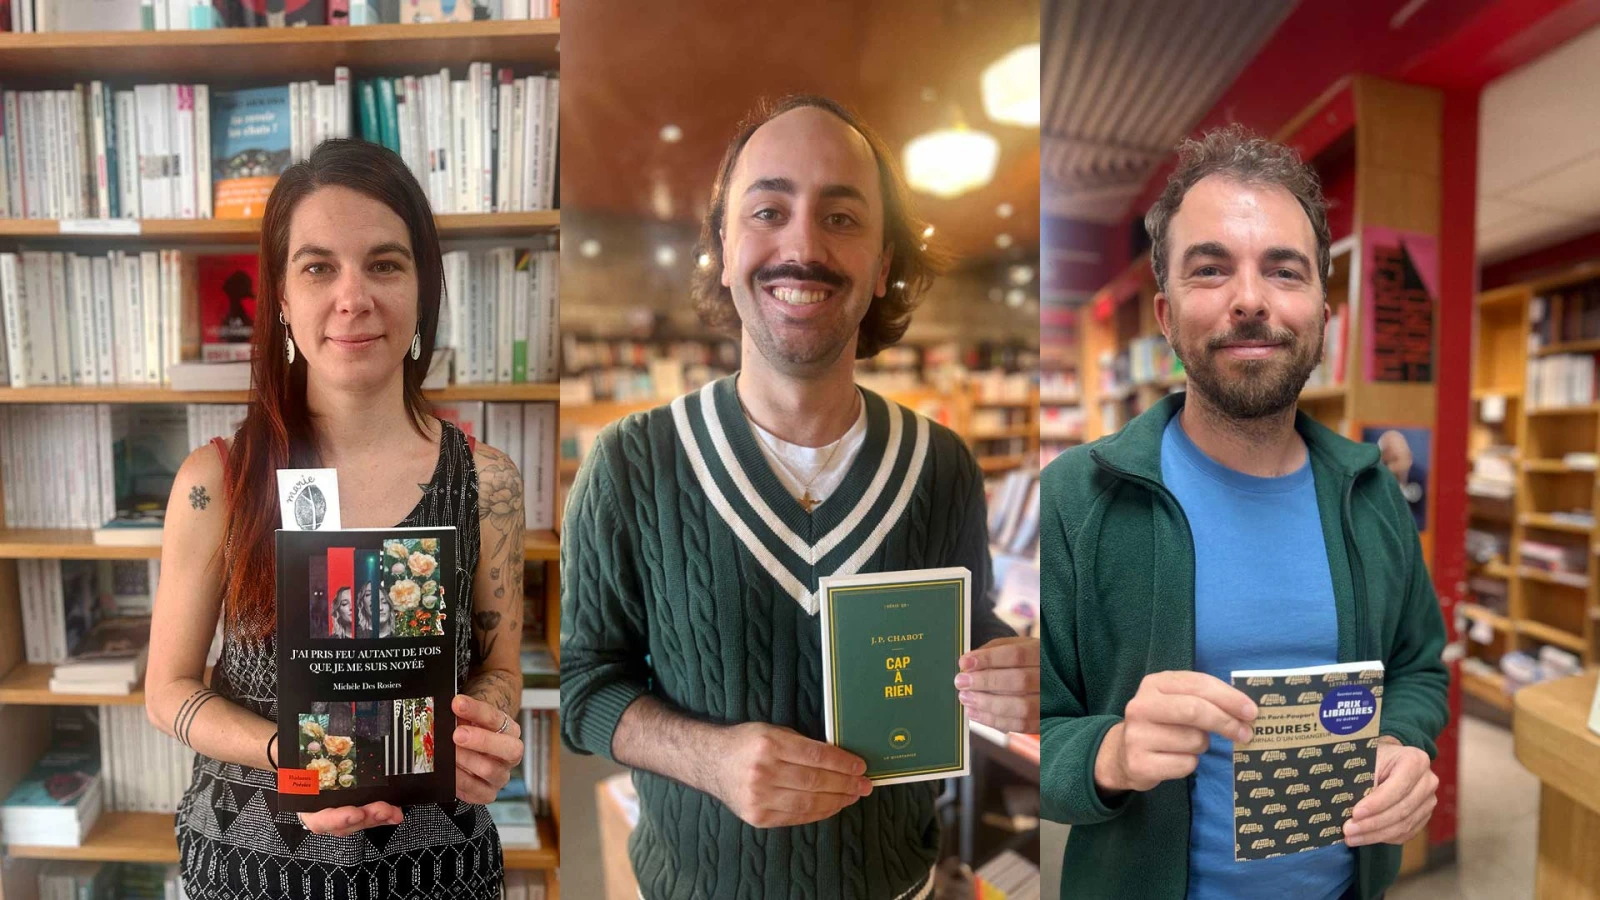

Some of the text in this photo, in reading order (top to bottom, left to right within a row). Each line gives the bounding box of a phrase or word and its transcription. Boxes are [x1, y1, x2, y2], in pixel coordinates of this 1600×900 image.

[286, 474, 316, 504] marie
[887, 633, 924, 643] CHABOT
[290, 646, 442, 660] J'AI PRIS FEU AUTANT DE FOIS
[309, 658, 425, 674] QUE JE ME SUIS NOYÉE
[886, 656, 911, 670] CAP
[894, 668, 903, 683] À
[333, 681, 402, 691] Michèle Des Rosiers
[884, 684, 913, 698] RIEN
[1337, 700, 1361, 709] PRIX
[1323, 706, 1373, 718] LIBRAIRES
[1252, 723, 1311, 735] RDURES
